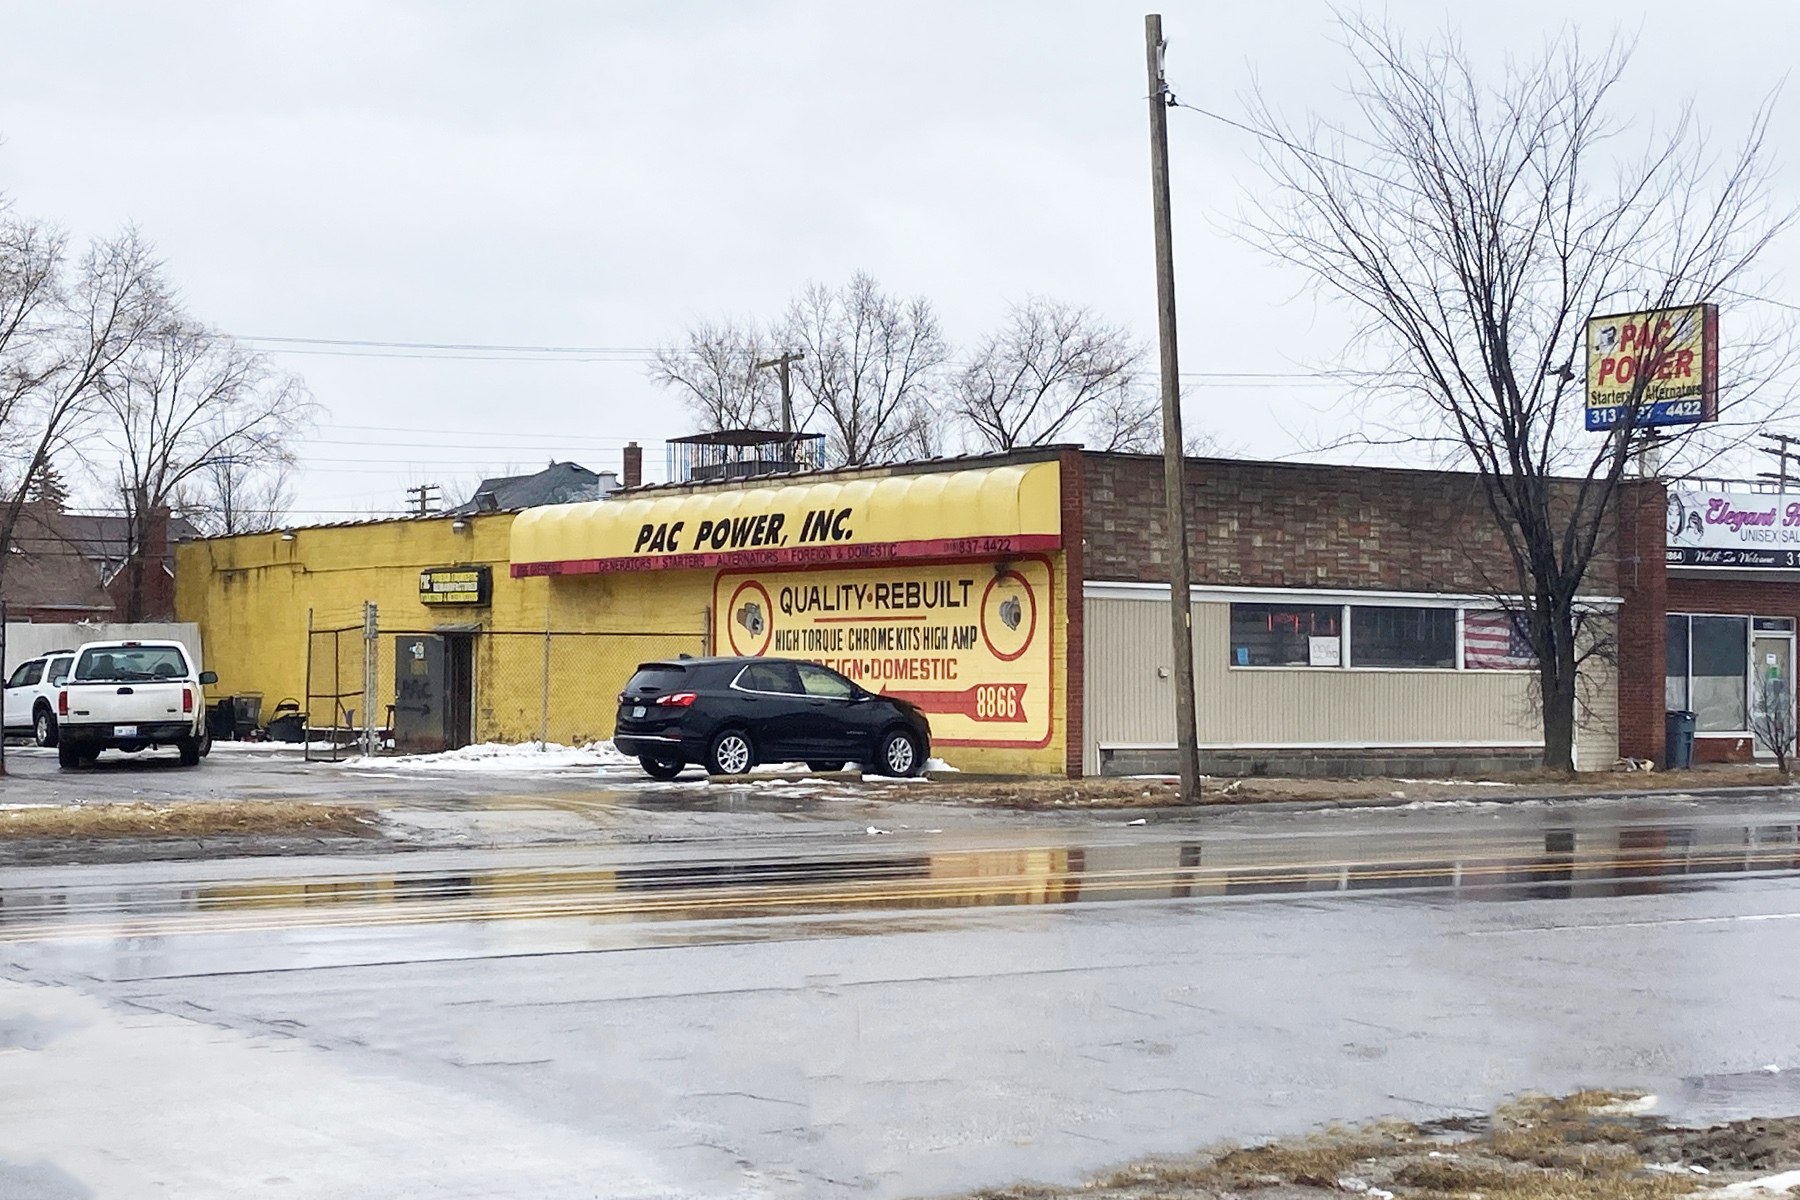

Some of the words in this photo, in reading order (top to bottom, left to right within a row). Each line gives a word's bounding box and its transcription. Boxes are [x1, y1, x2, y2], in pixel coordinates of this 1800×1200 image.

[1620, 320, 1671, 352] PAC
[1591, 389, 1631, 405] Starters
[1644, 382, 1701, 401] Alternators
[1591, 408, 1617, 423] 313
[1665, 401, 1701, 417] 4422
[1705, 498, 1777, 532] Elegant
[634, 521, 685, 553] PAC
[693, 513, 788, 550] POWER,
[799, 508, 853, 543] INC.
[1740, 529, 1779, 542] UNISEX
[599, 556, 652, 573] GENERATORS
[662, 553, 706, 569] STARTERS
[716, 551, 779, 566] ALTERNATORS
[791, 547, 832, 562] FOREIGN
[848, 543, 897, 559] DOMESTIC
[1666, 551, 1683, 560] 864
[780, 582, 868, 616] QUALITY
[875, 579, 974, 609] REBUILT
[775, 629, 800, 652] HIGH
[802, 628, 843, 653] TORQUE
[849, 627, 894, 651] CHROME
[897, 626, 920, 650] KITS
[923, 626, 948, 651] HIGH
[951, 625, 977, 650] AMP
[870, 658, 958, 681] DOMESTIC
[977, 686, 1016, 718] 8866
